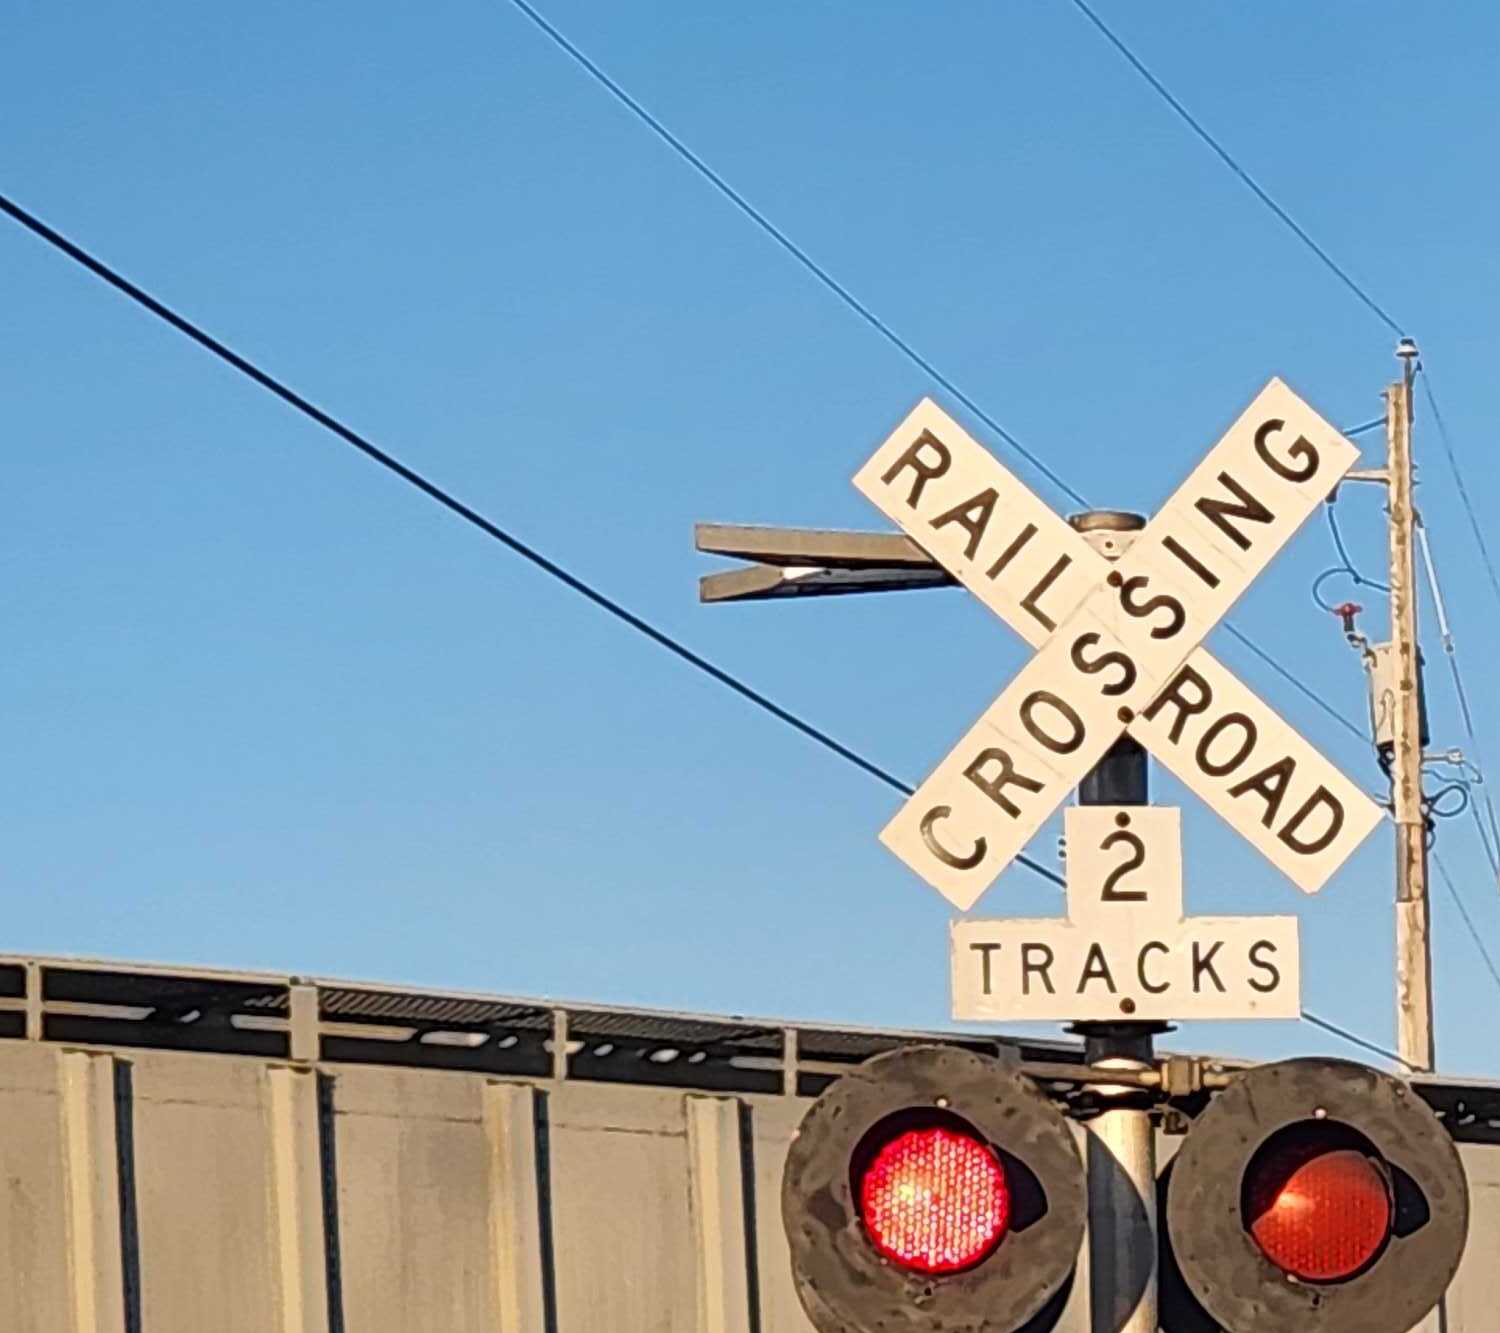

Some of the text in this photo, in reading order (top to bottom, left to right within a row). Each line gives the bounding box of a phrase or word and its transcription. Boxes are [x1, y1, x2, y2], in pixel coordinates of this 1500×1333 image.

[881, 428, 1346, 855] RAIL ROAD
[919, 418, 1321, 871] CROSSING
[969, 939, 1282, 995] TRACKS
[1100, 830, 1148, 902] 2
